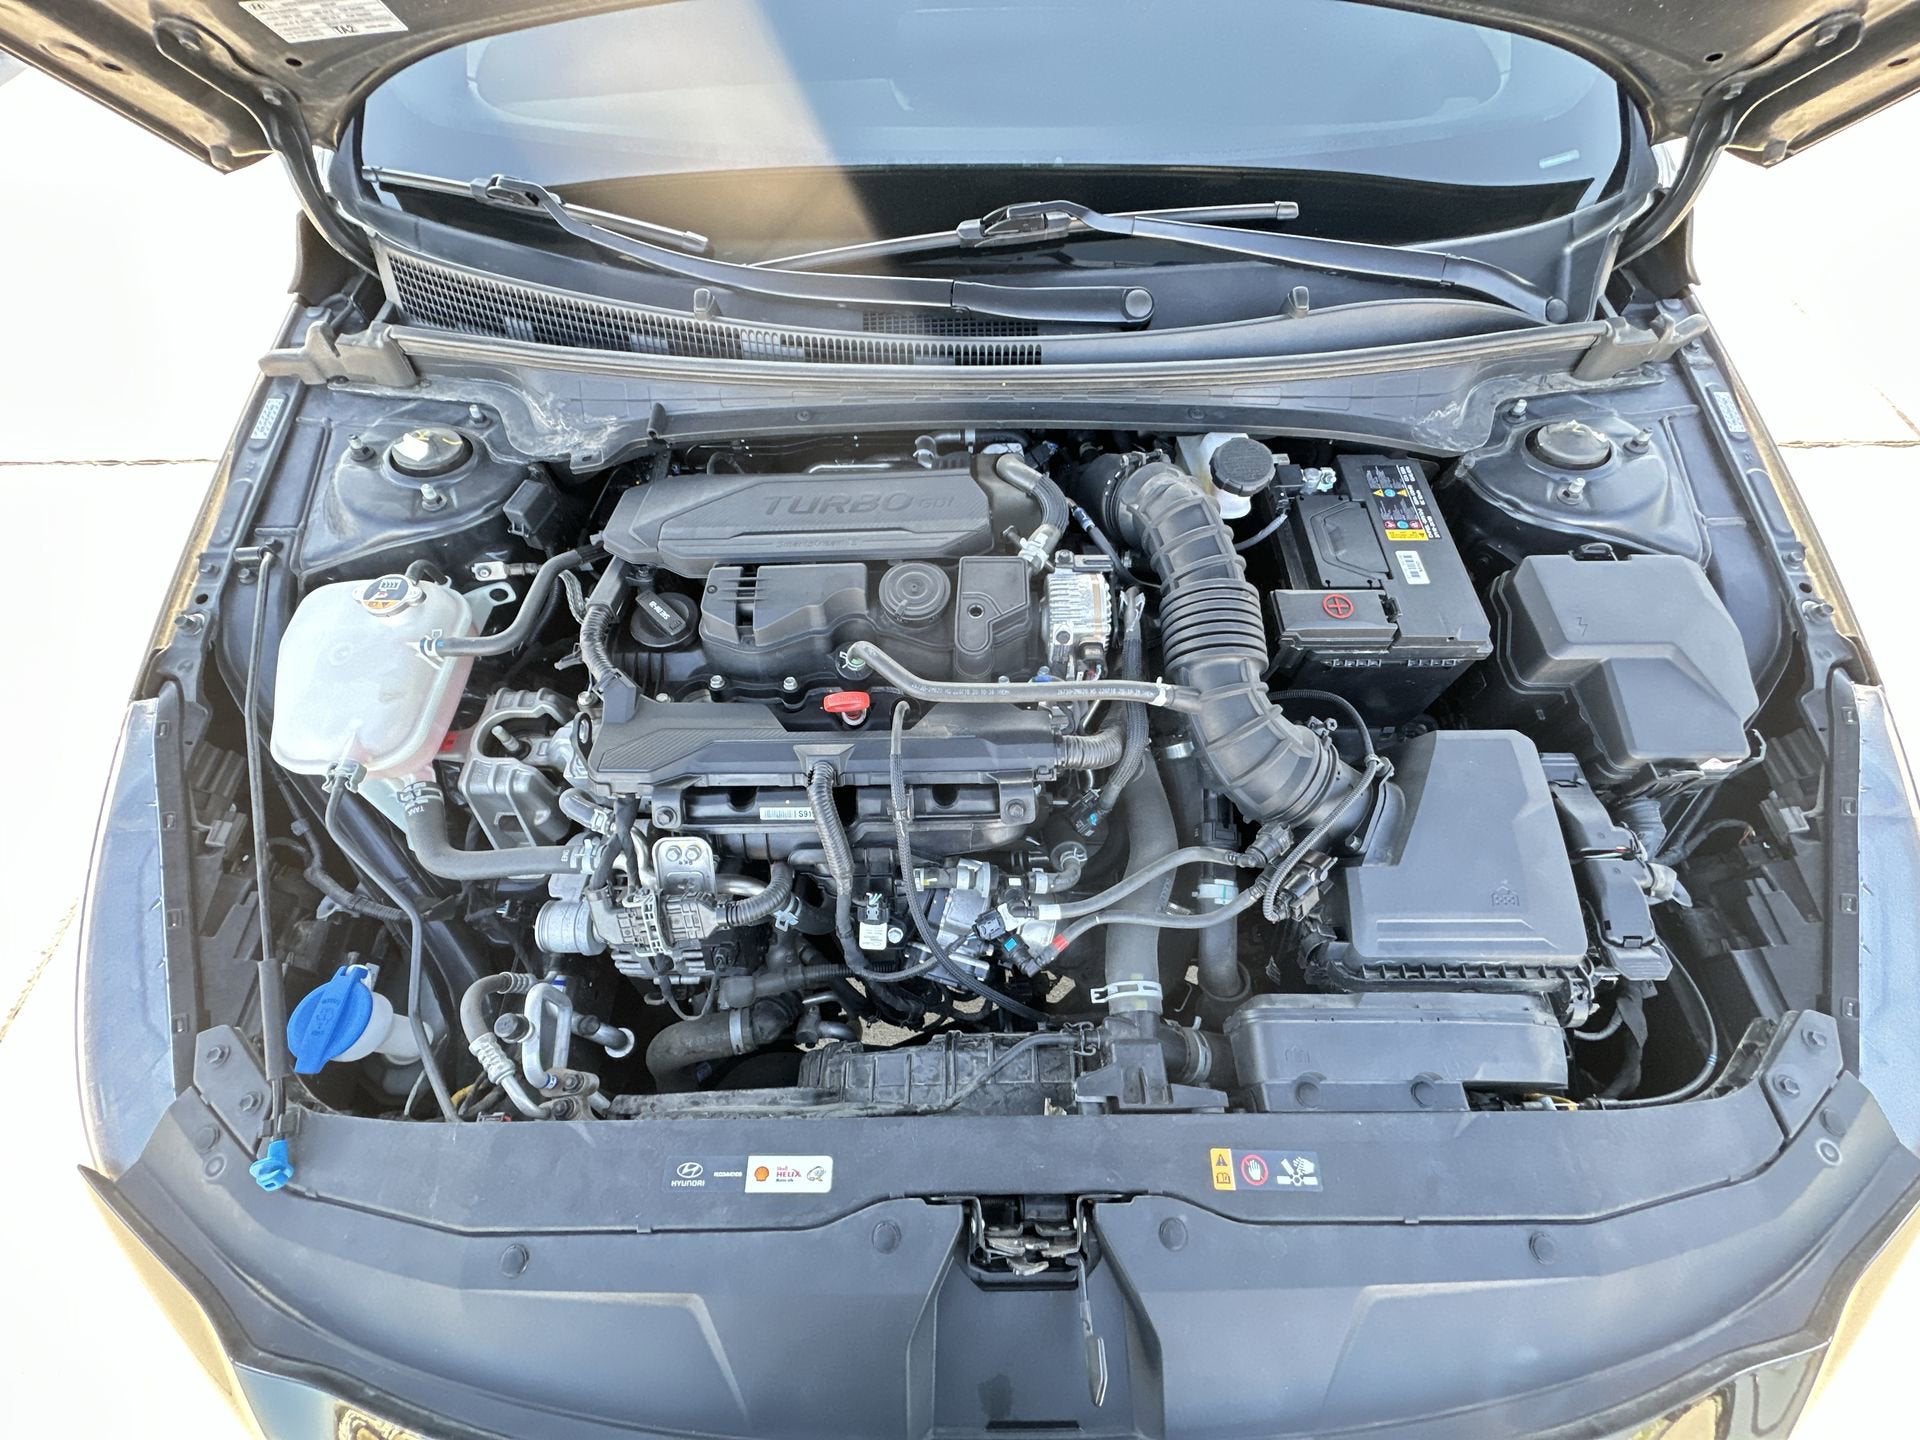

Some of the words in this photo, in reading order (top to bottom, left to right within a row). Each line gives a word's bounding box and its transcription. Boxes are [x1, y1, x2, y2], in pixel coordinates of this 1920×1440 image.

[334, 24, 358, 35] TA2
[764, 492, 914, 516] TURBO
[776, 1169, 802, 1178] HELIX
